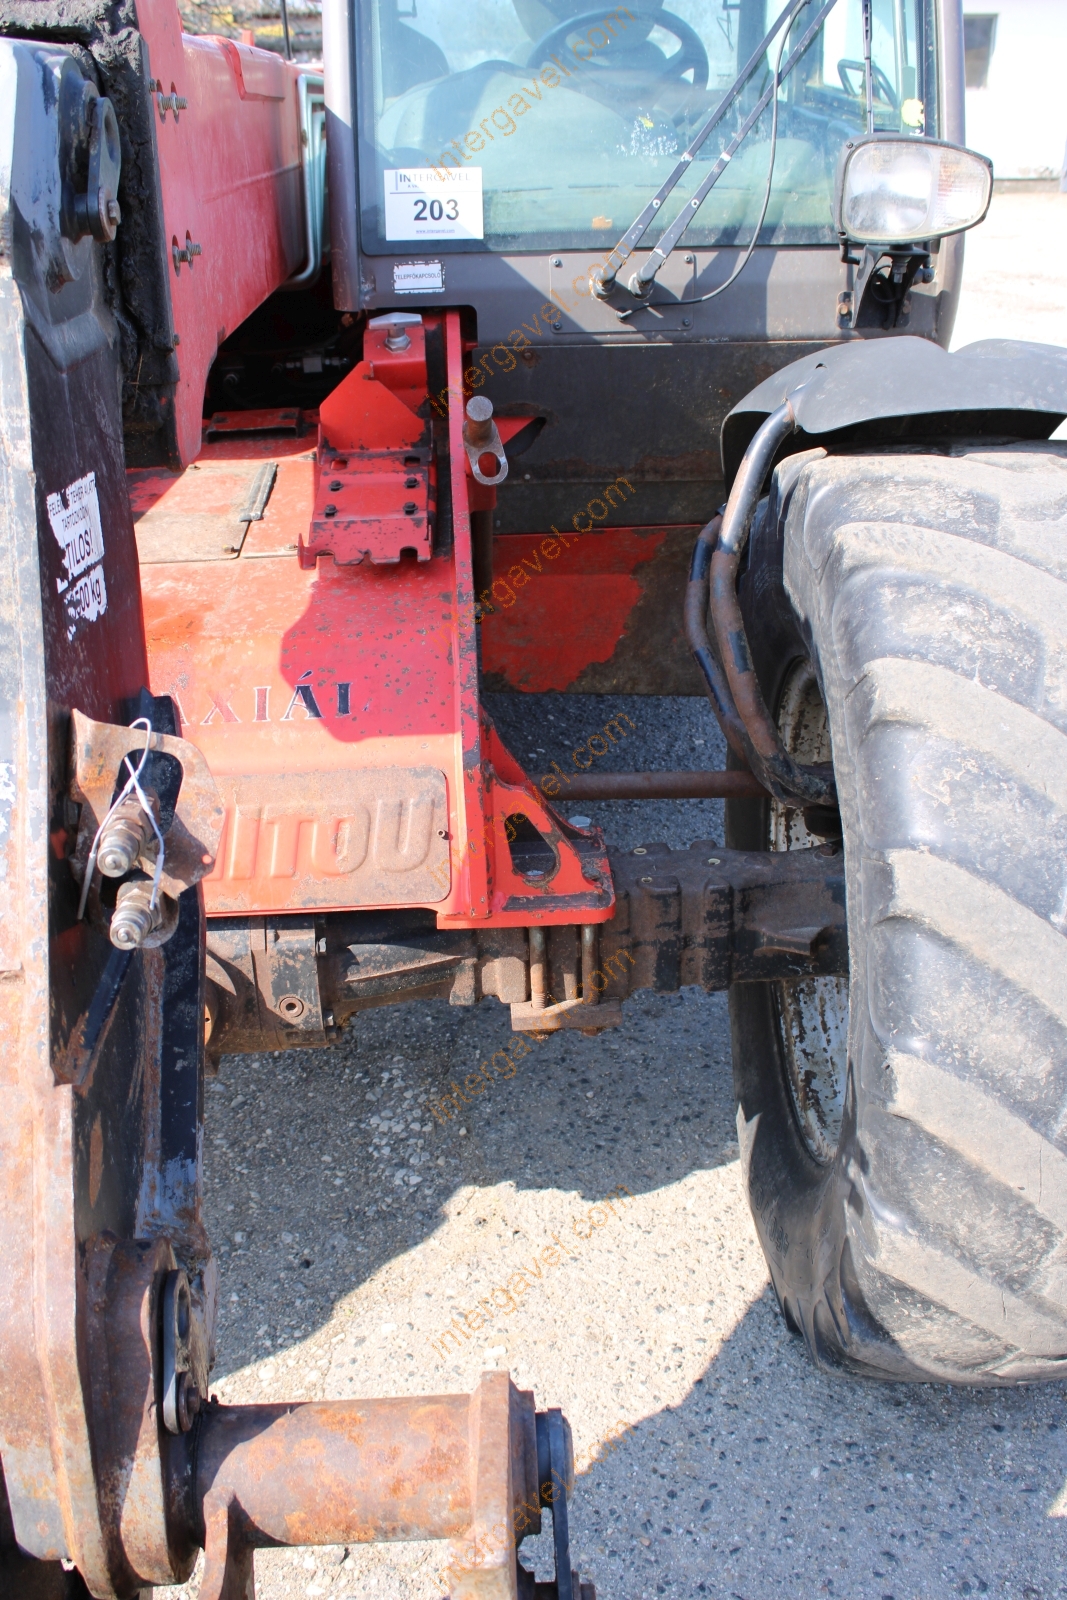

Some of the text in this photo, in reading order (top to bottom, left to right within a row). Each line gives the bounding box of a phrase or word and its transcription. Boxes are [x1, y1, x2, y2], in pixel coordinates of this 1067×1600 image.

[413, 198, 460, 221] 203
[65, 527, 93, 570] TILOS!
[90, 577, 102, 606] kg
